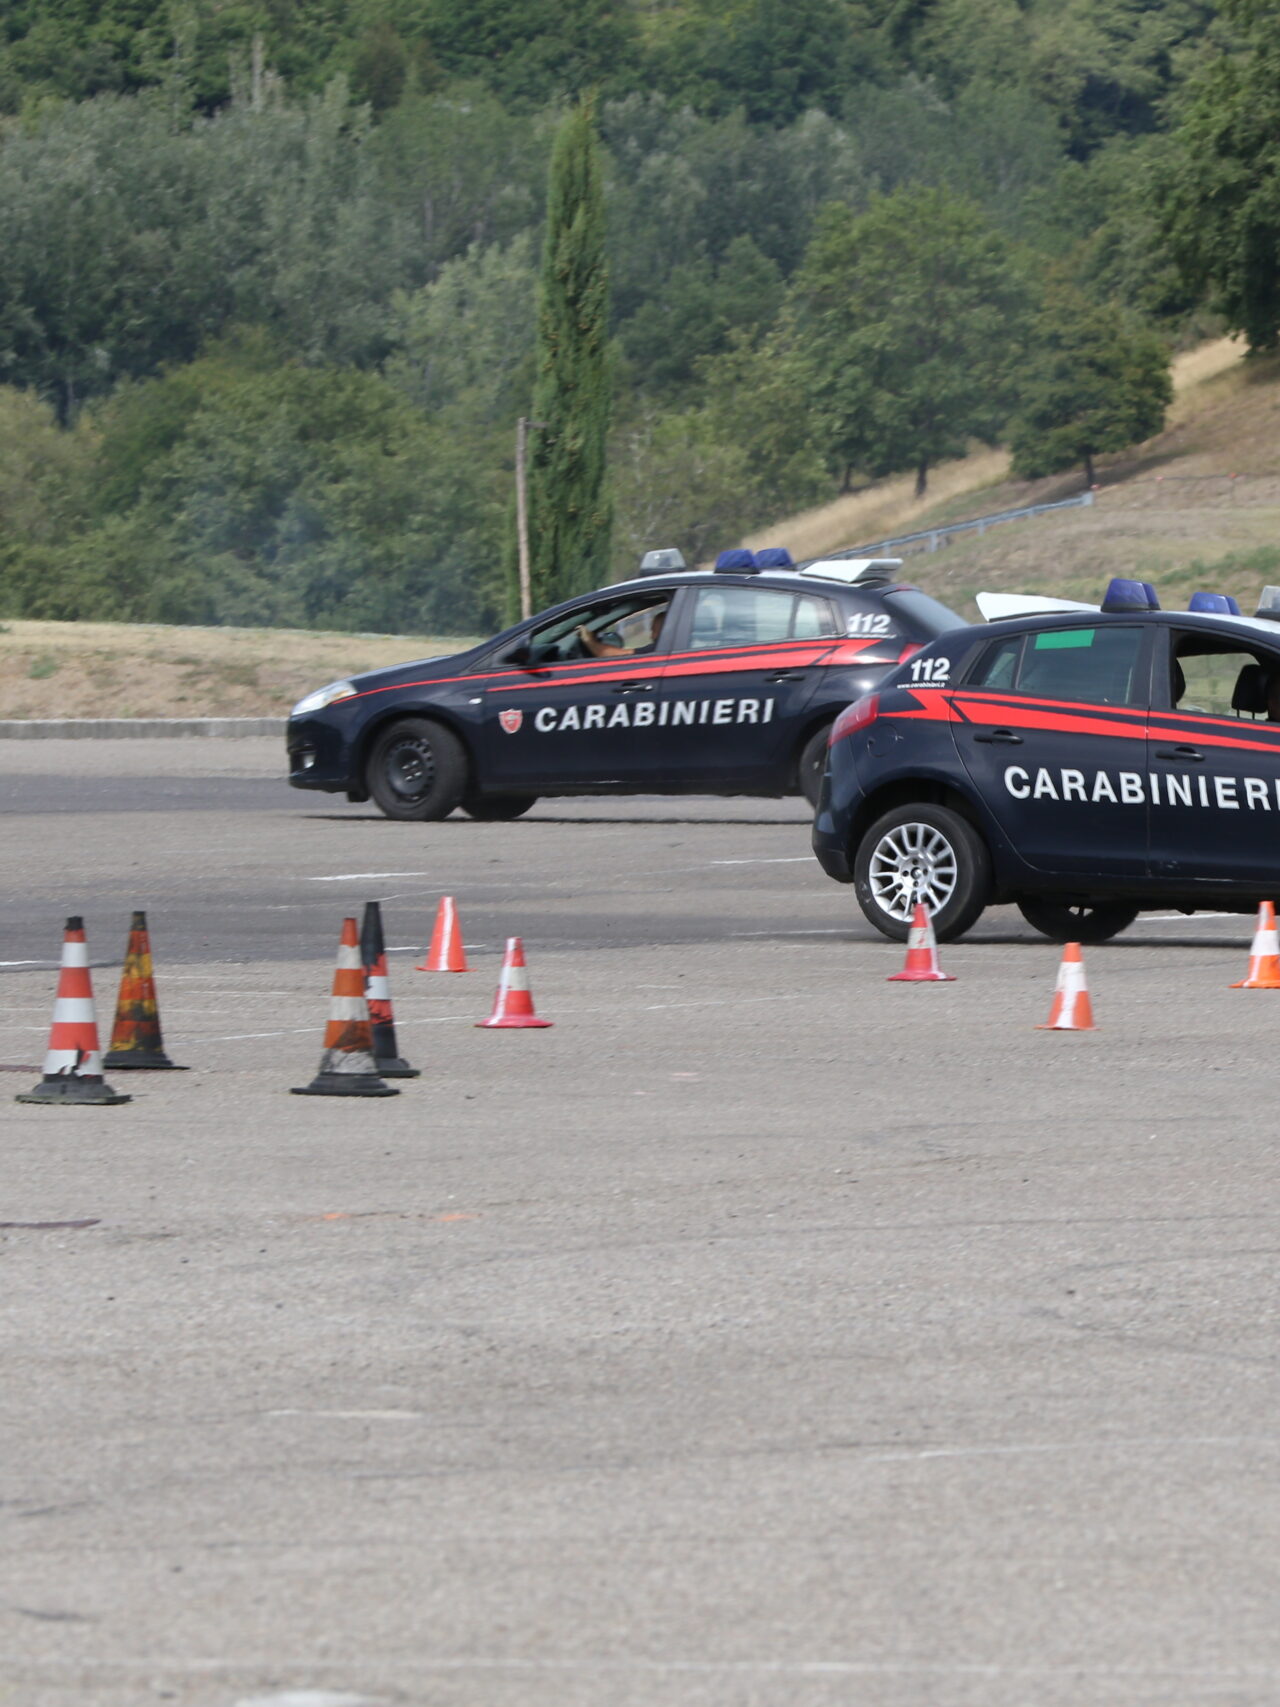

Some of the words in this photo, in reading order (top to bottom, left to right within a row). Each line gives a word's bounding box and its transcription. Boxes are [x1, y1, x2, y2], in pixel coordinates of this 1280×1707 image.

[847, 612, 891, 633] 112
[911, 656, 950, 681] 112
[534, 698, 774, 732] CARABINIERI
